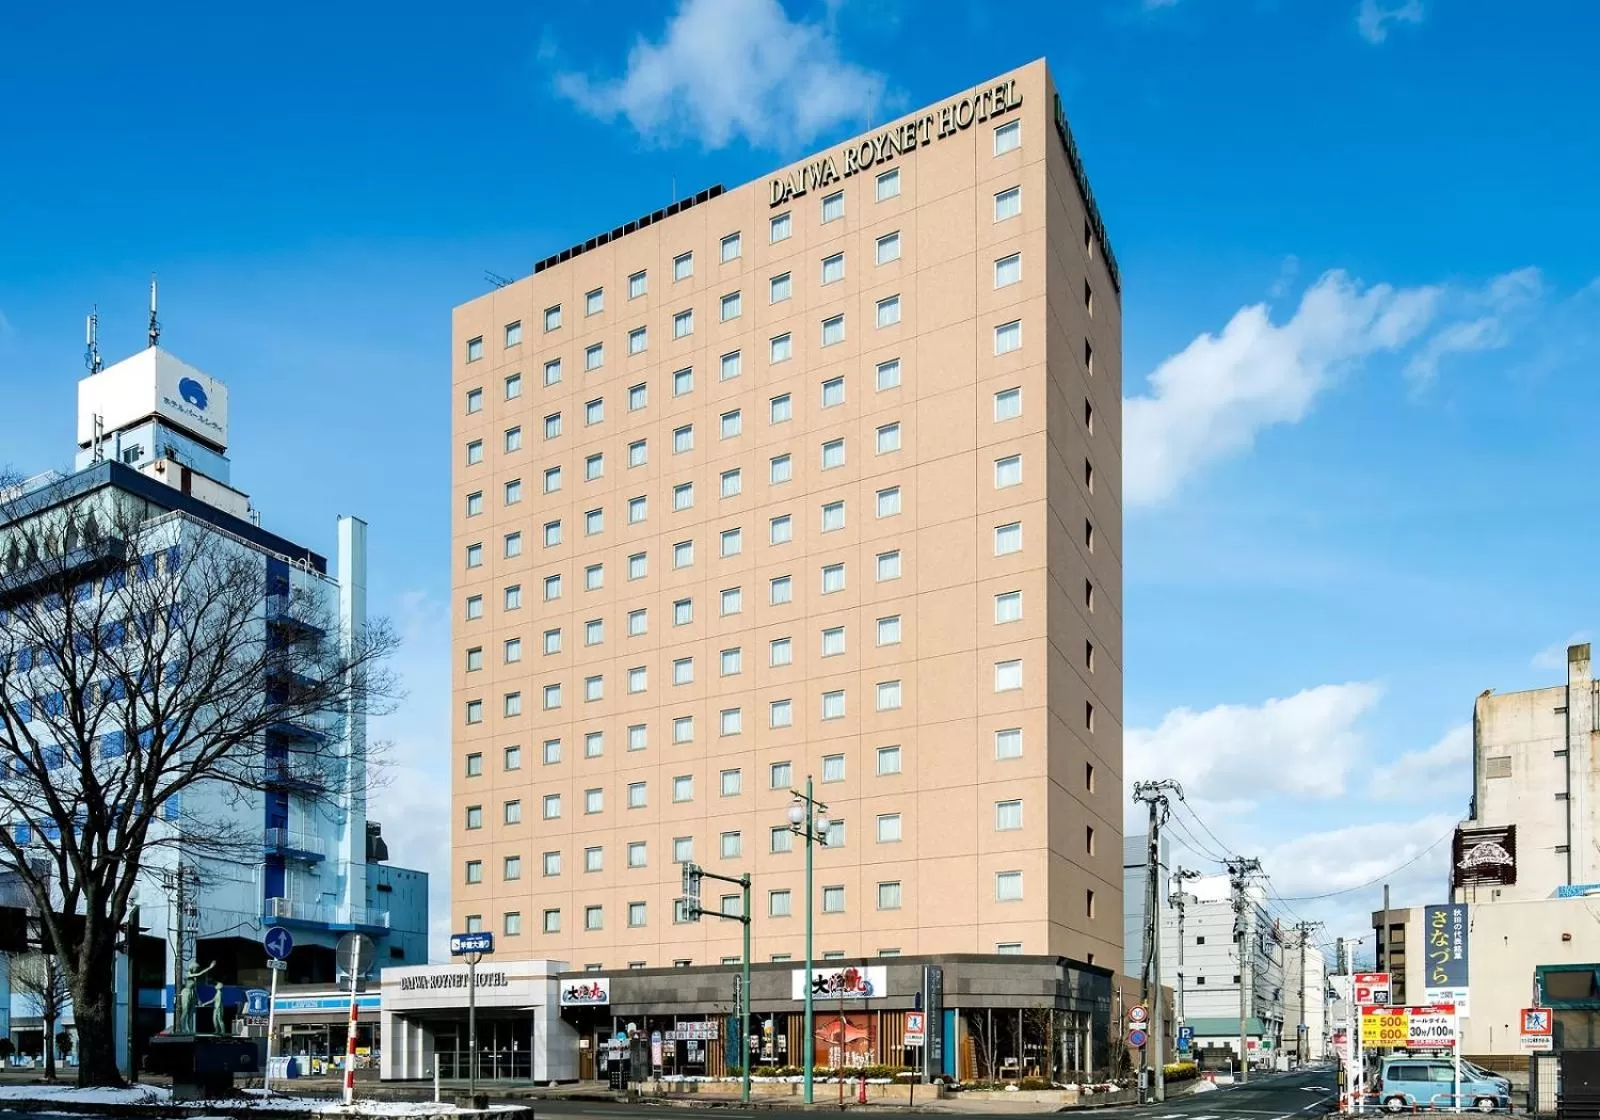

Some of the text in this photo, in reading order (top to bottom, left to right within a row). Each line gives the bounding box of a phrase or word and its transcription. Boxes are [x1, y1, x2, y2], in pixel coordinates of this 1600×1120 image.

[768, 79, 1024, 208] DAIWA ROYNET HOTEL
[1429, 911, 1451, 985] さなづら
[401, 976, 428, 990] DAIWA
[430, 973, 469, 989] ROYNET
[1357, 988, 1370, 1002] P
[1182, 1028, 1190, 1038] P
